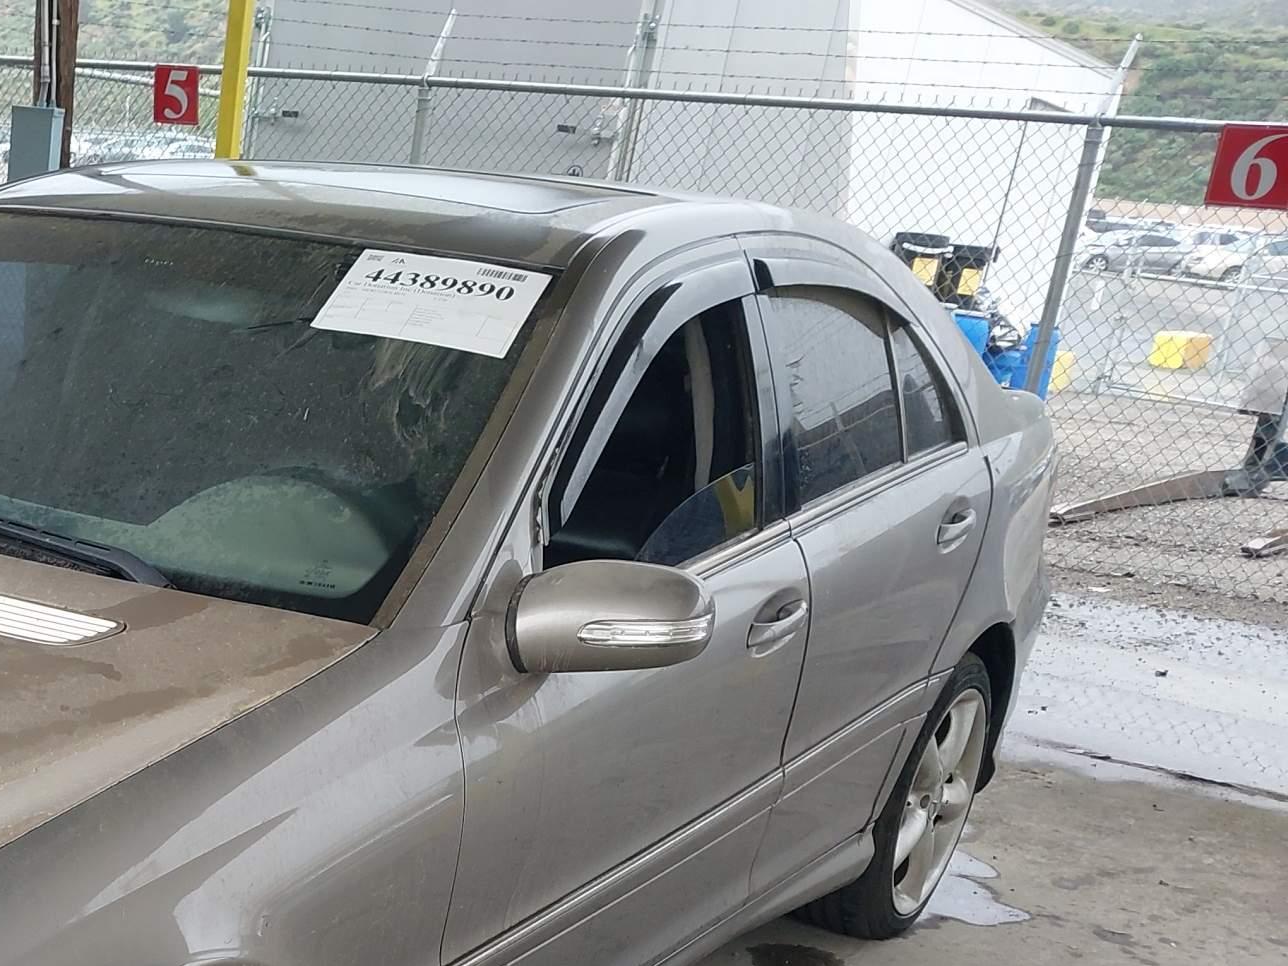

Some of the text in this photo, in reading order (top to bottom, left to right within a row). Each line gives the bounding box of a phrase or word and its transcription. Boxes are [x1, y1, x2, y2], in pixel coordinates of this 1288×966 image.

[163, 70, 189, 119] 5
[1230, 133, 1288, 200] 6
[364, 268, 515, 301] 44389890
